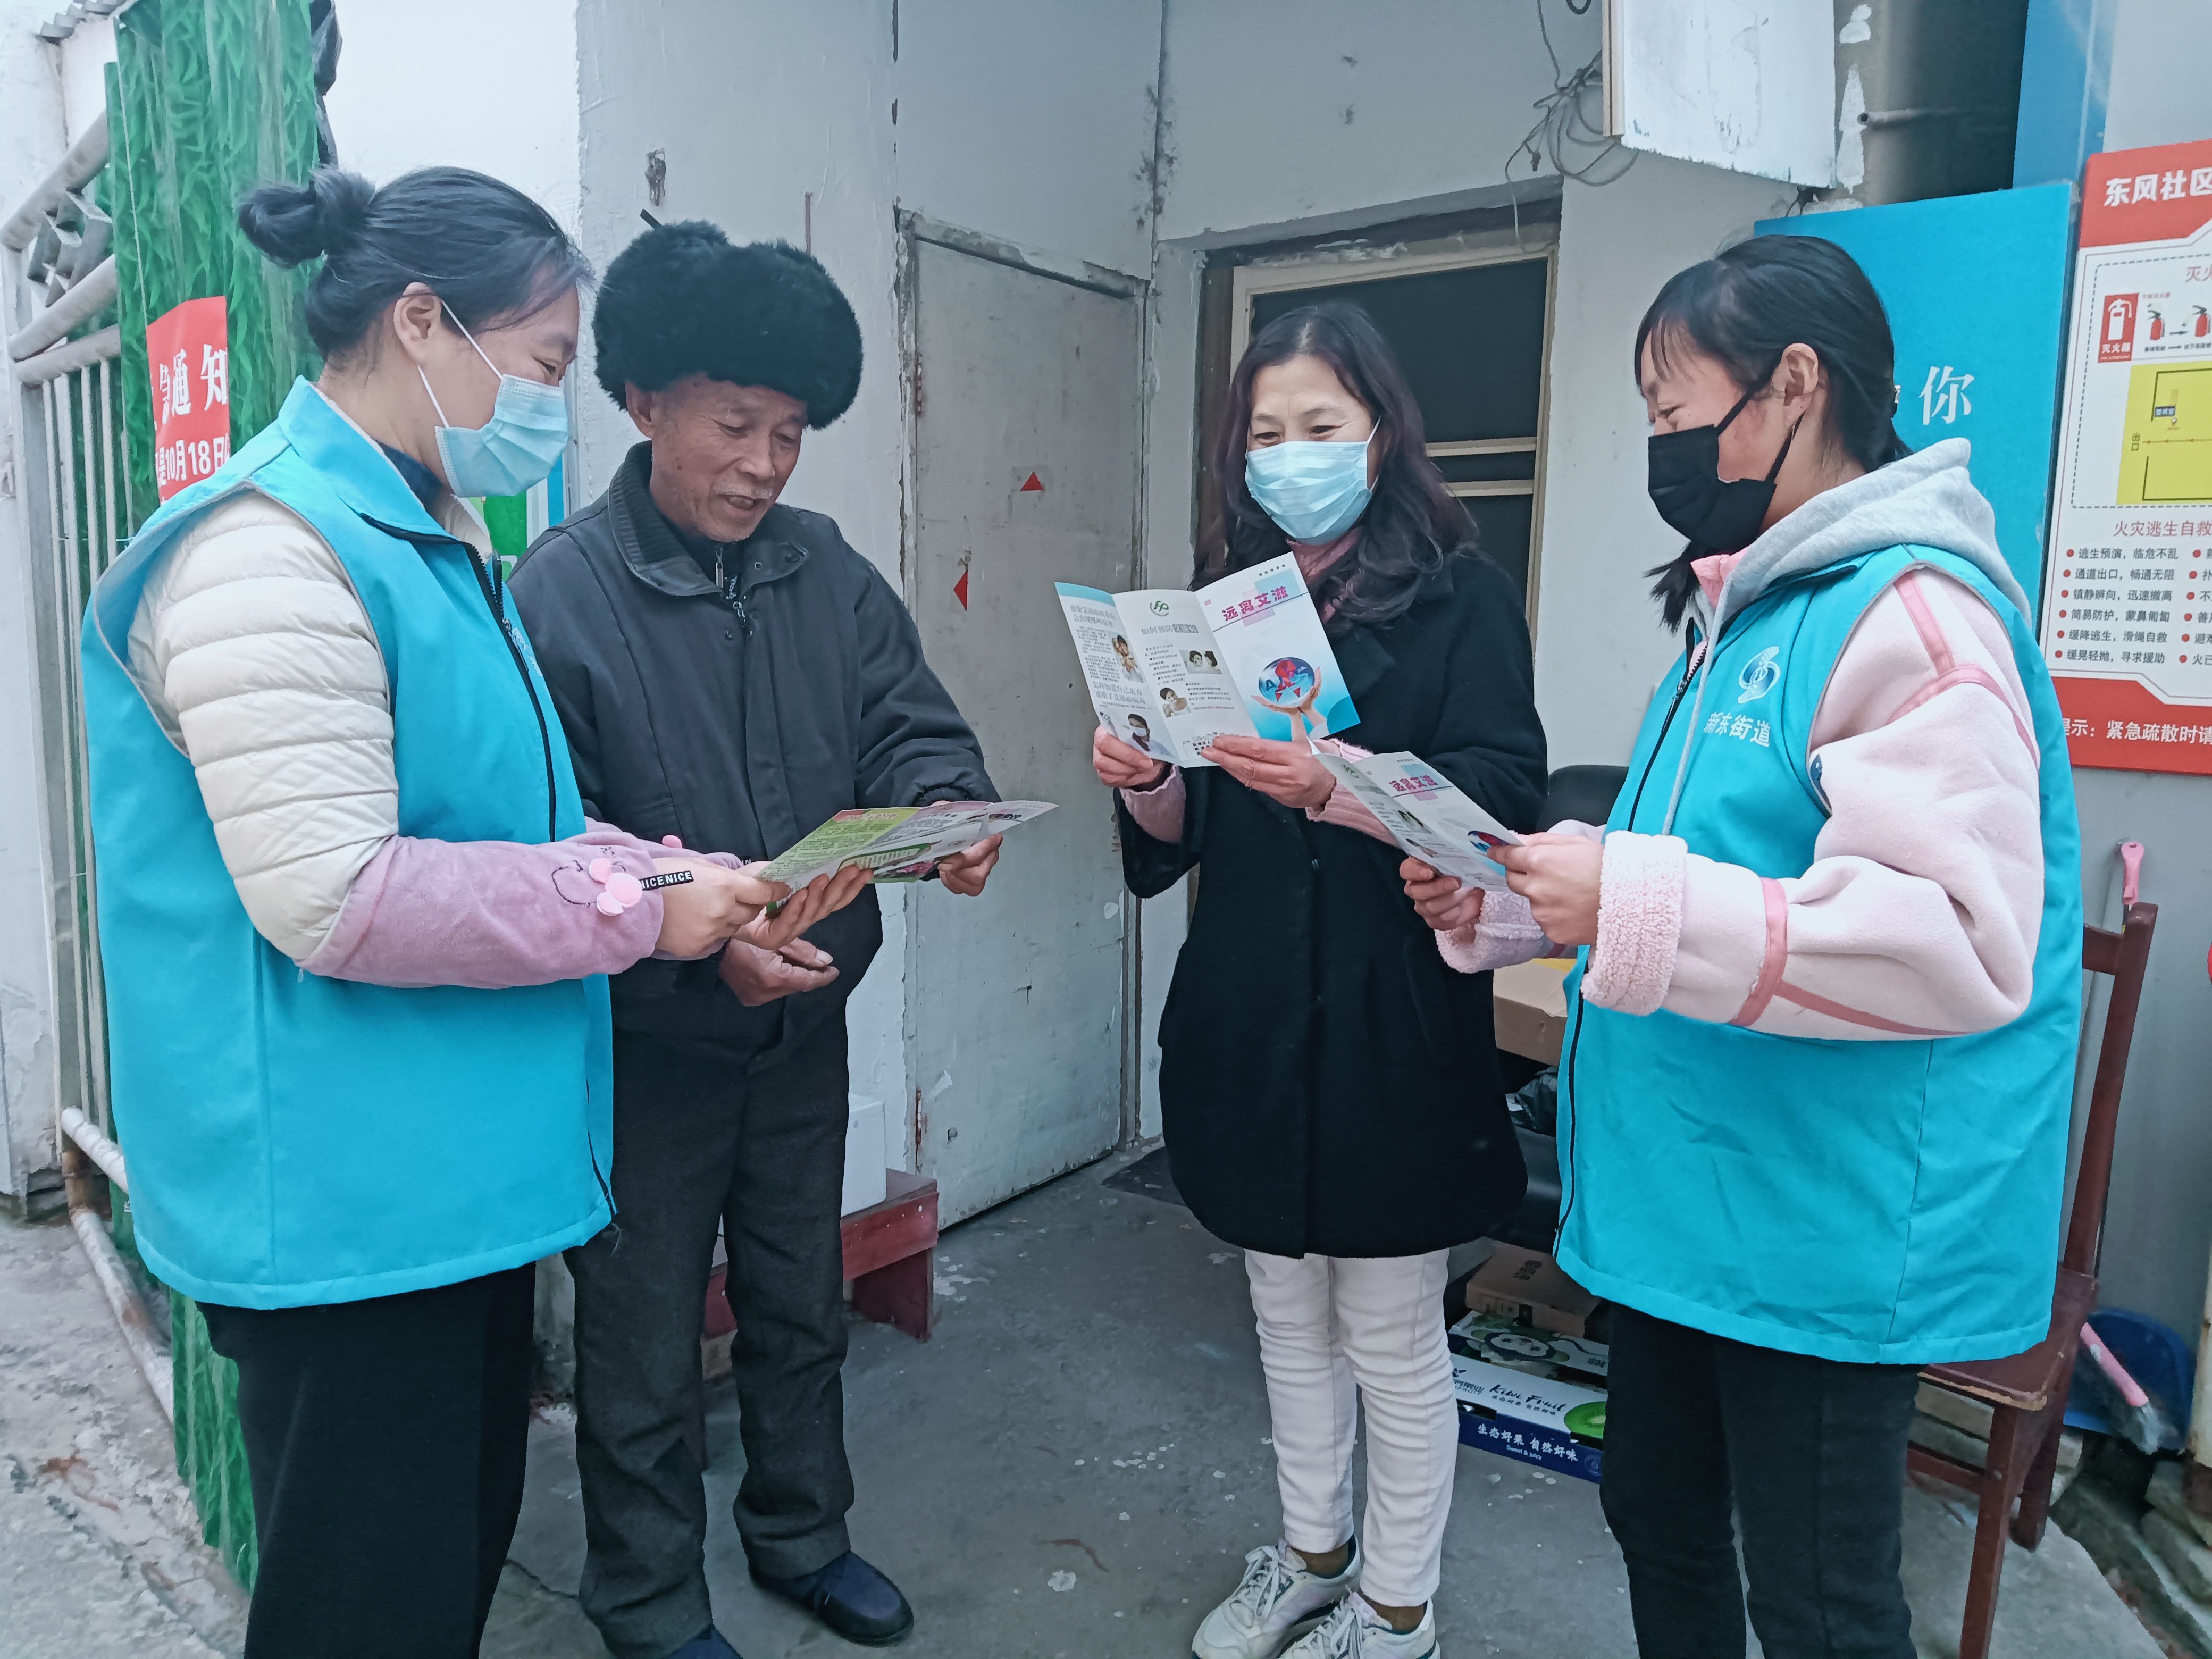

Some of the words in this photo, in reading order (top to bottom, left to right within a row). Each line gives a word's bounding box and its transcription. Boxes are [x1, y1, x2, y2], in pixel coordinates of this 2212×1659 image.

[2104, 167, 2212, 207] 东风社区
[1918, 365, 1975, 425] 你
[2114, 520, 2212, 537] 火灾逃生自救
[1222, 586, 1288, 622] 远离艾滋
[2199, 590, 2212, 602] 不
[1703, 711, 1770, 747] 新东街道
[665, 872, 692, 884] NICE
[1526, 1394, 1566, 1411] Fruit
[1478, 1423, 1524, 1446] 生态好果
[1530, 1437, 1578, 1461] 自然好味
